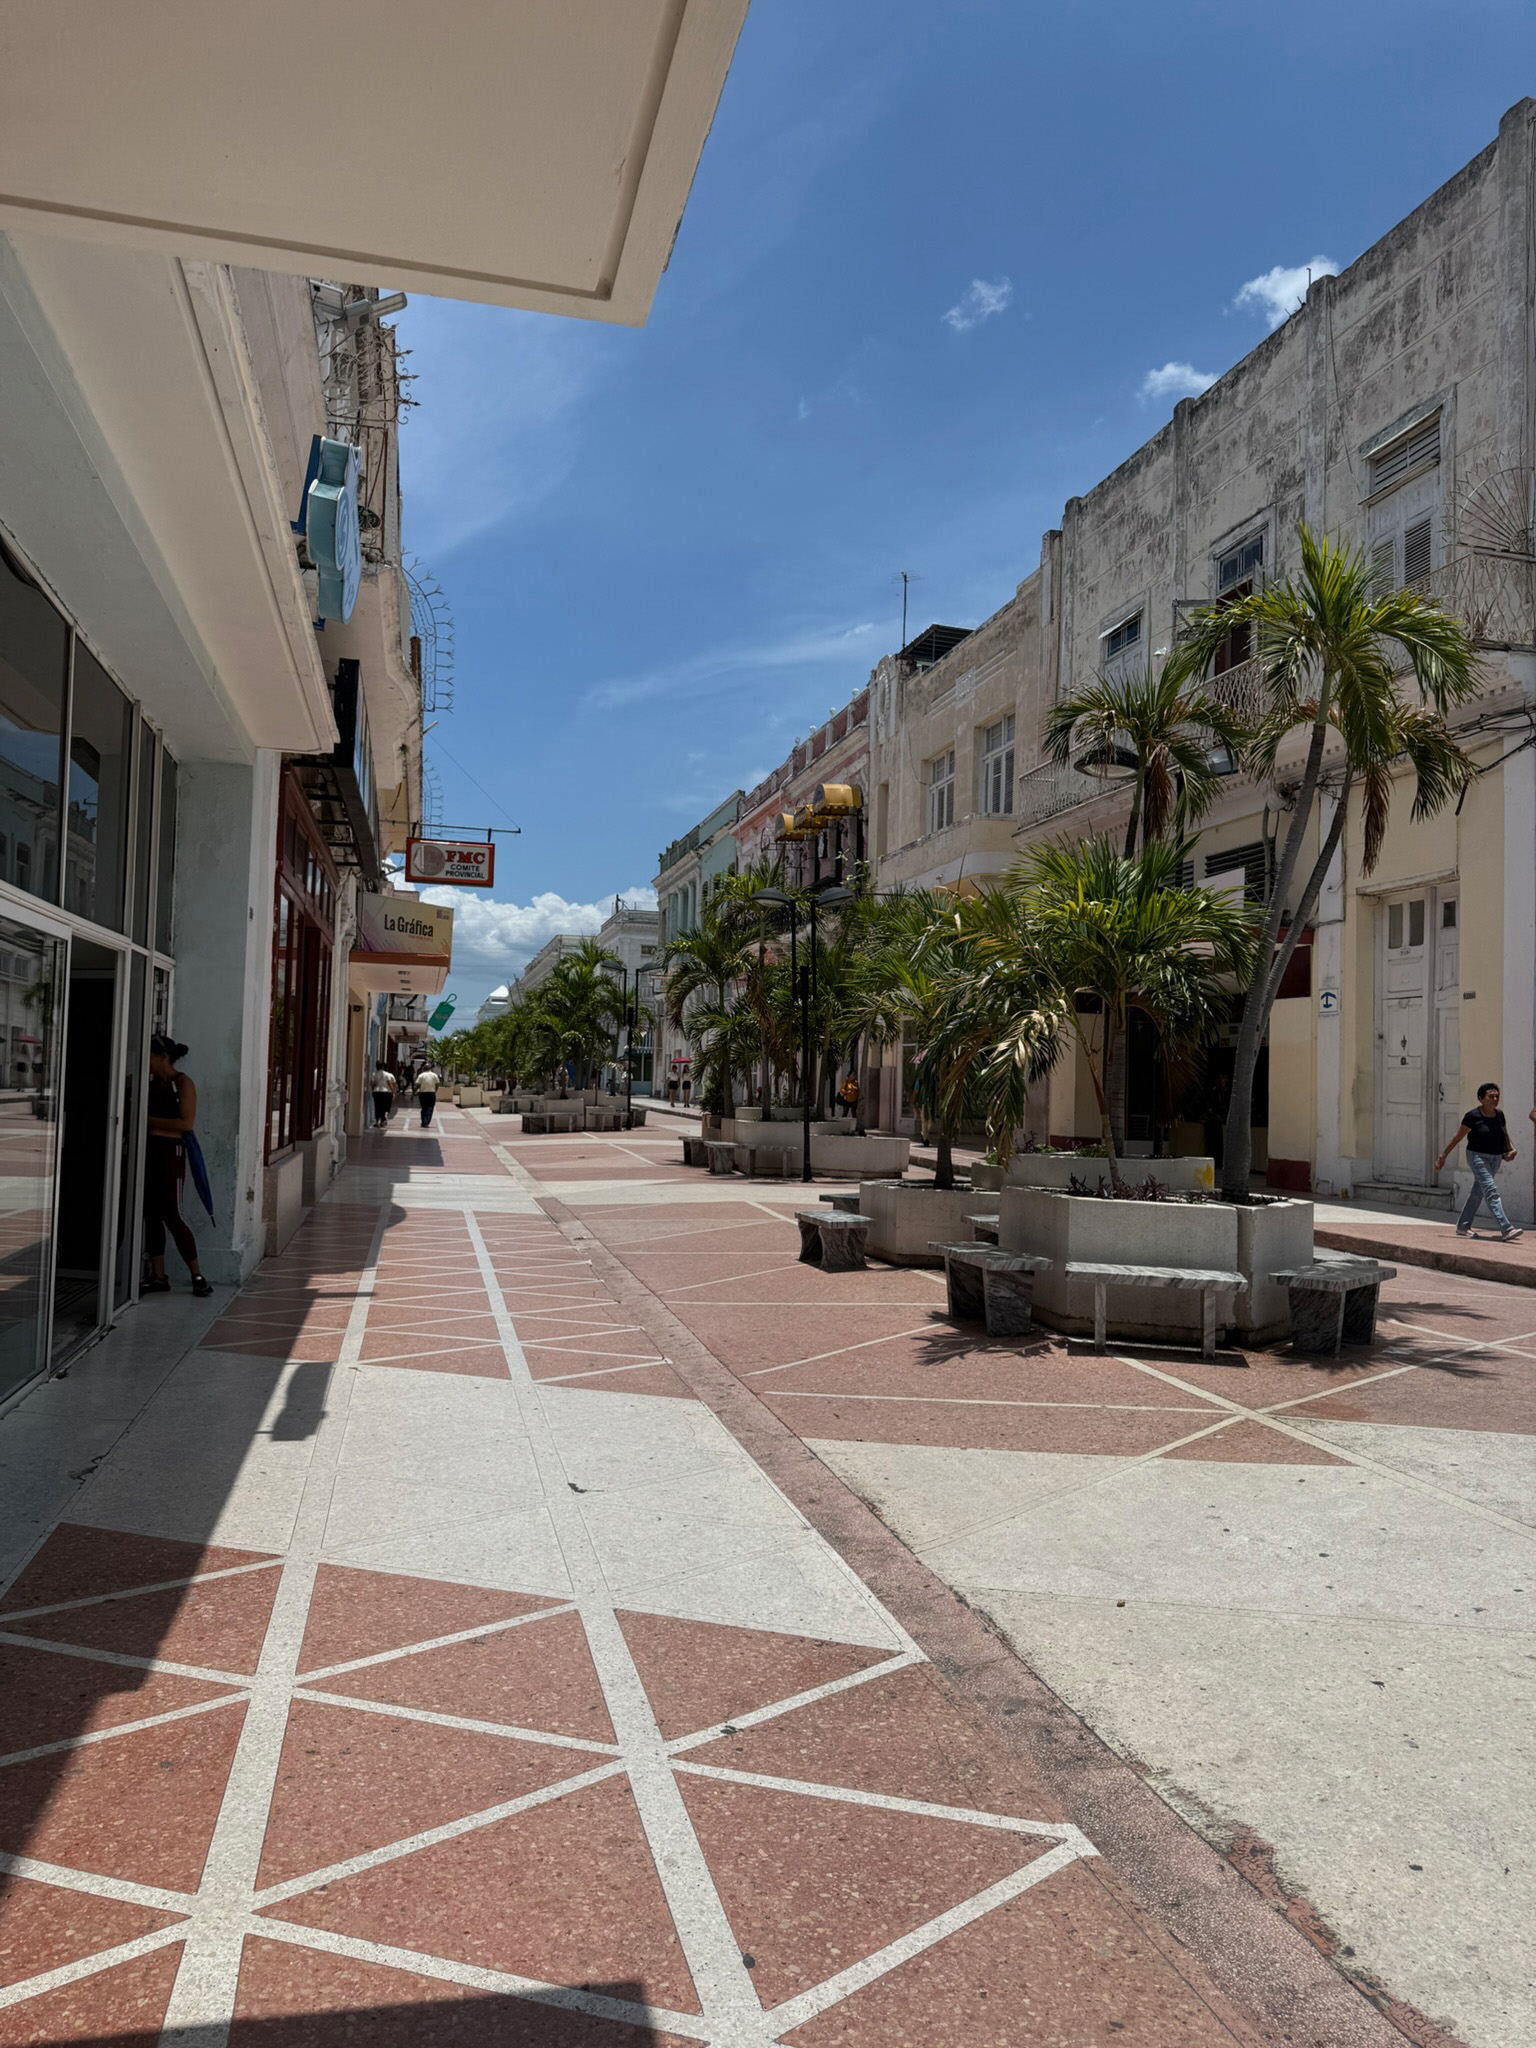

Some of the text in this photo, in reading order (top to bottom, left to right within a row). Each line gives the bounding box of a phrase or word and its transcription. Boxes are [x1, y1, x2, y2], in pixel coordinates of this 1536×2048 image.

[445, 850, 485, 864] FMC
[450, 864, 480, 872] COMITE
[445, 870, 485, 878] PROVINCIAL
[384, 914, 433, 937] La Gráfica
